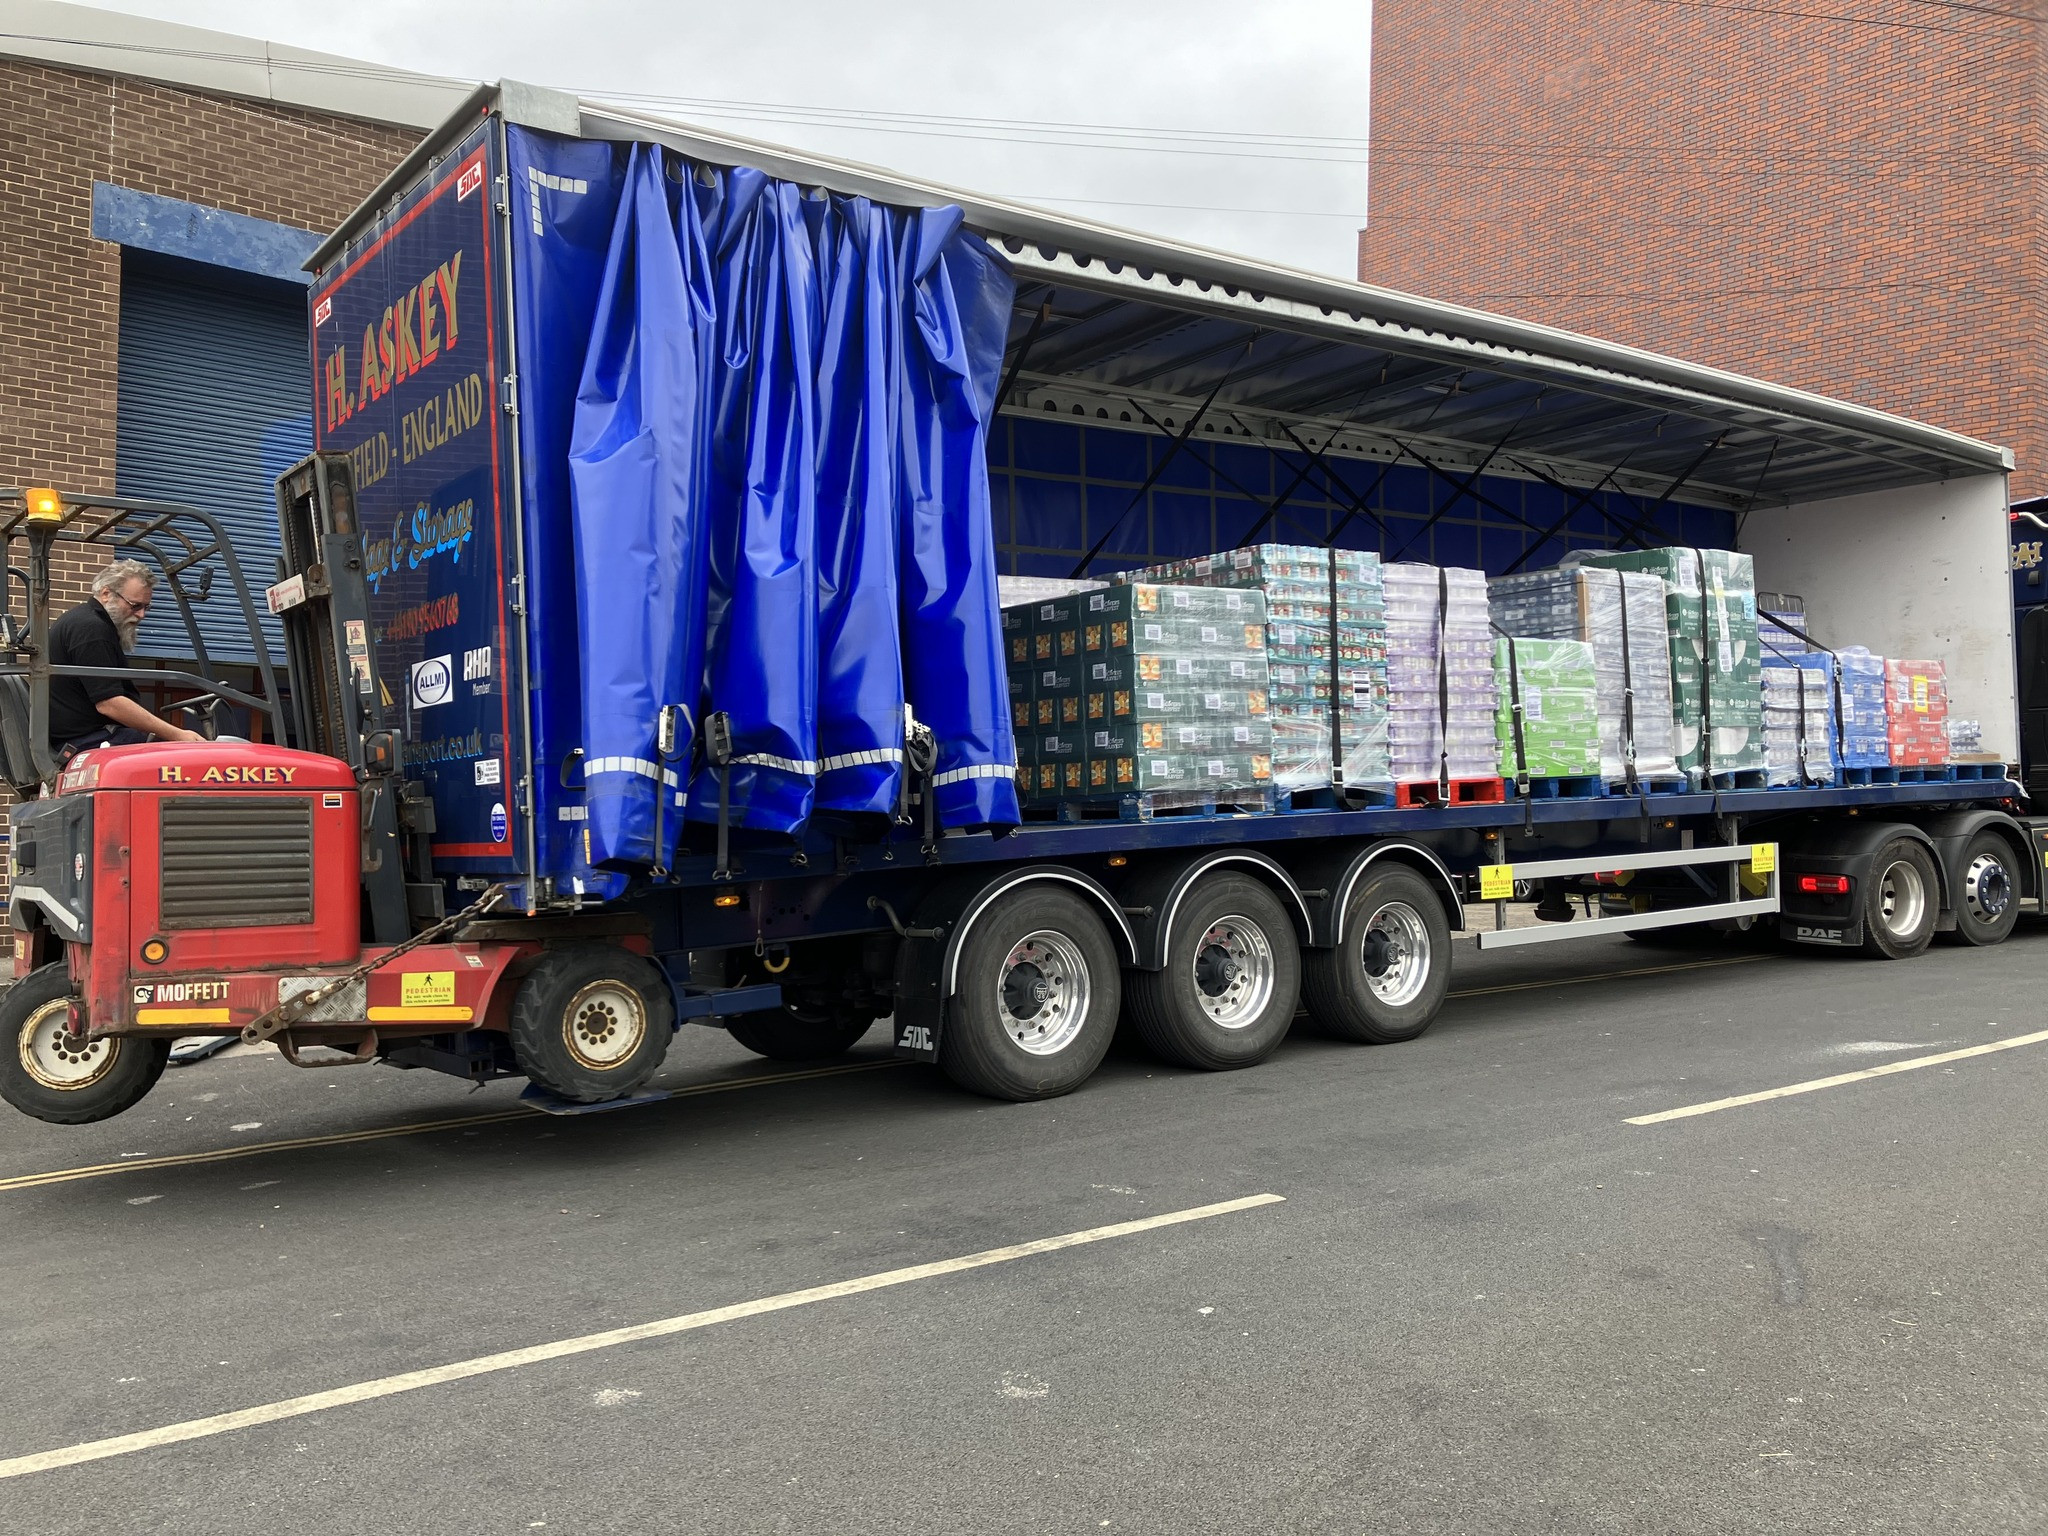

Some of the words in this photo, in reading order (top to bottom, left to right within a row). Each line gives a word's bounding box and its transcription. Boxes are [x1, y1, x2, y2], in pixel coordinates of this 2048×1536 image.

[325, 345, 355, 433] H.
[358, 249, 463, 412] ASKEY
[350, 431, 389, 492] FIELD
[402, 372, 483, 465] ENGLAND
[409, 498, 473, 570] Storage
[463, 646, 491, 682] RHA
[419, 671, 445, 690] ALLMI
[472, 682, 491, 696] Member
[158, 765, 192, 784] H.
[198, 766, 298, 785] ASKEY
[1797, 926, 1842, 939] DAF
[157, 982, 230, 1003] MOFFETT
